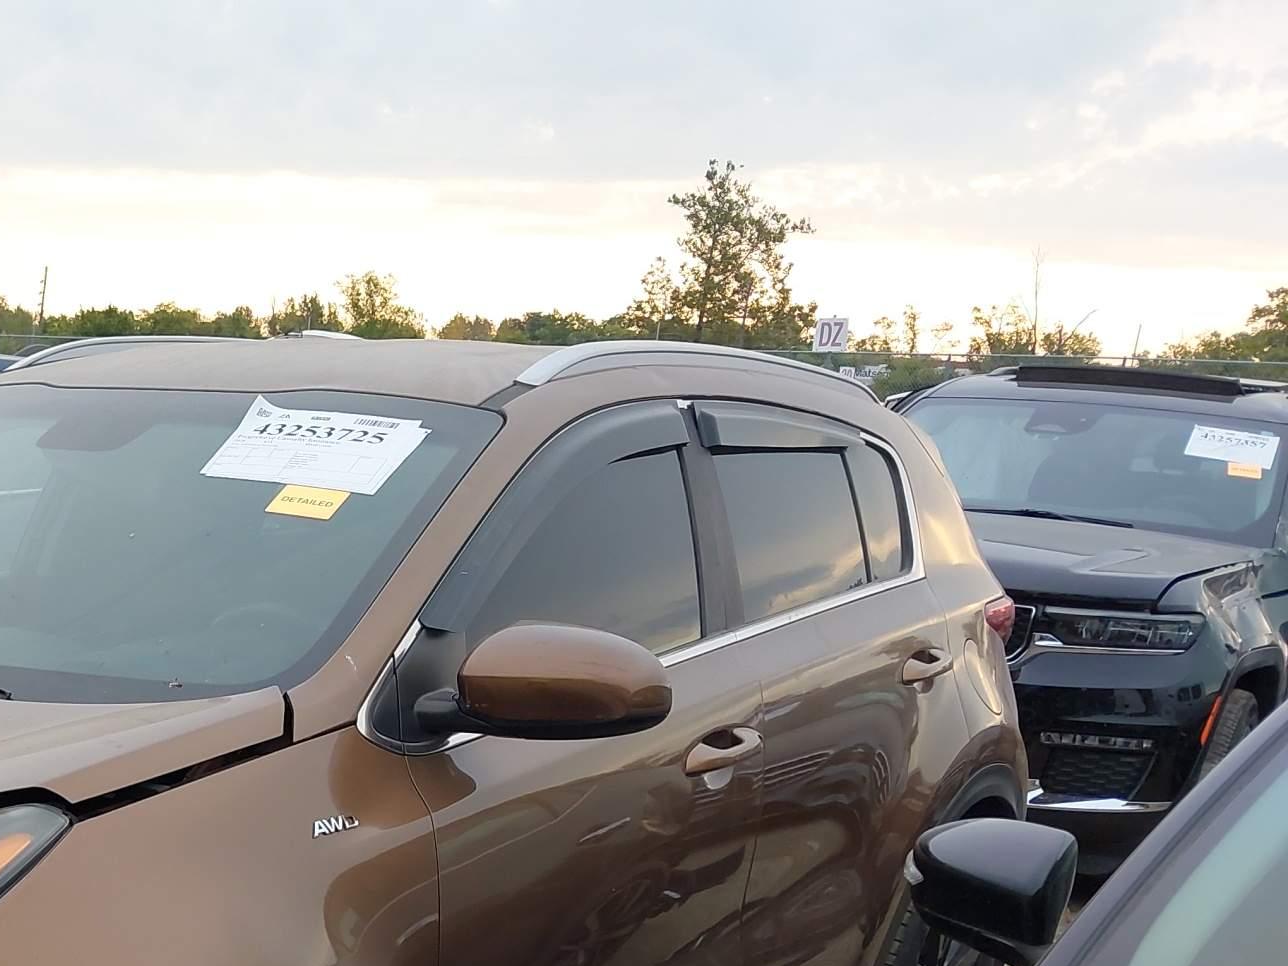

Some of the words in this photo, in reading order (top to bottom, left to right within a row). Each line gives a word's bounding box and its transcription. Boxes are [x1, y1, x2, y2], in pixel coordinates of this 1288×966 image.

[818, 321, 845, 347] DZ
[253, 422, 388, 445] 43253725
[280, 495, 334, 508] DETAILED
[312, 814, 360, 839] AWD
